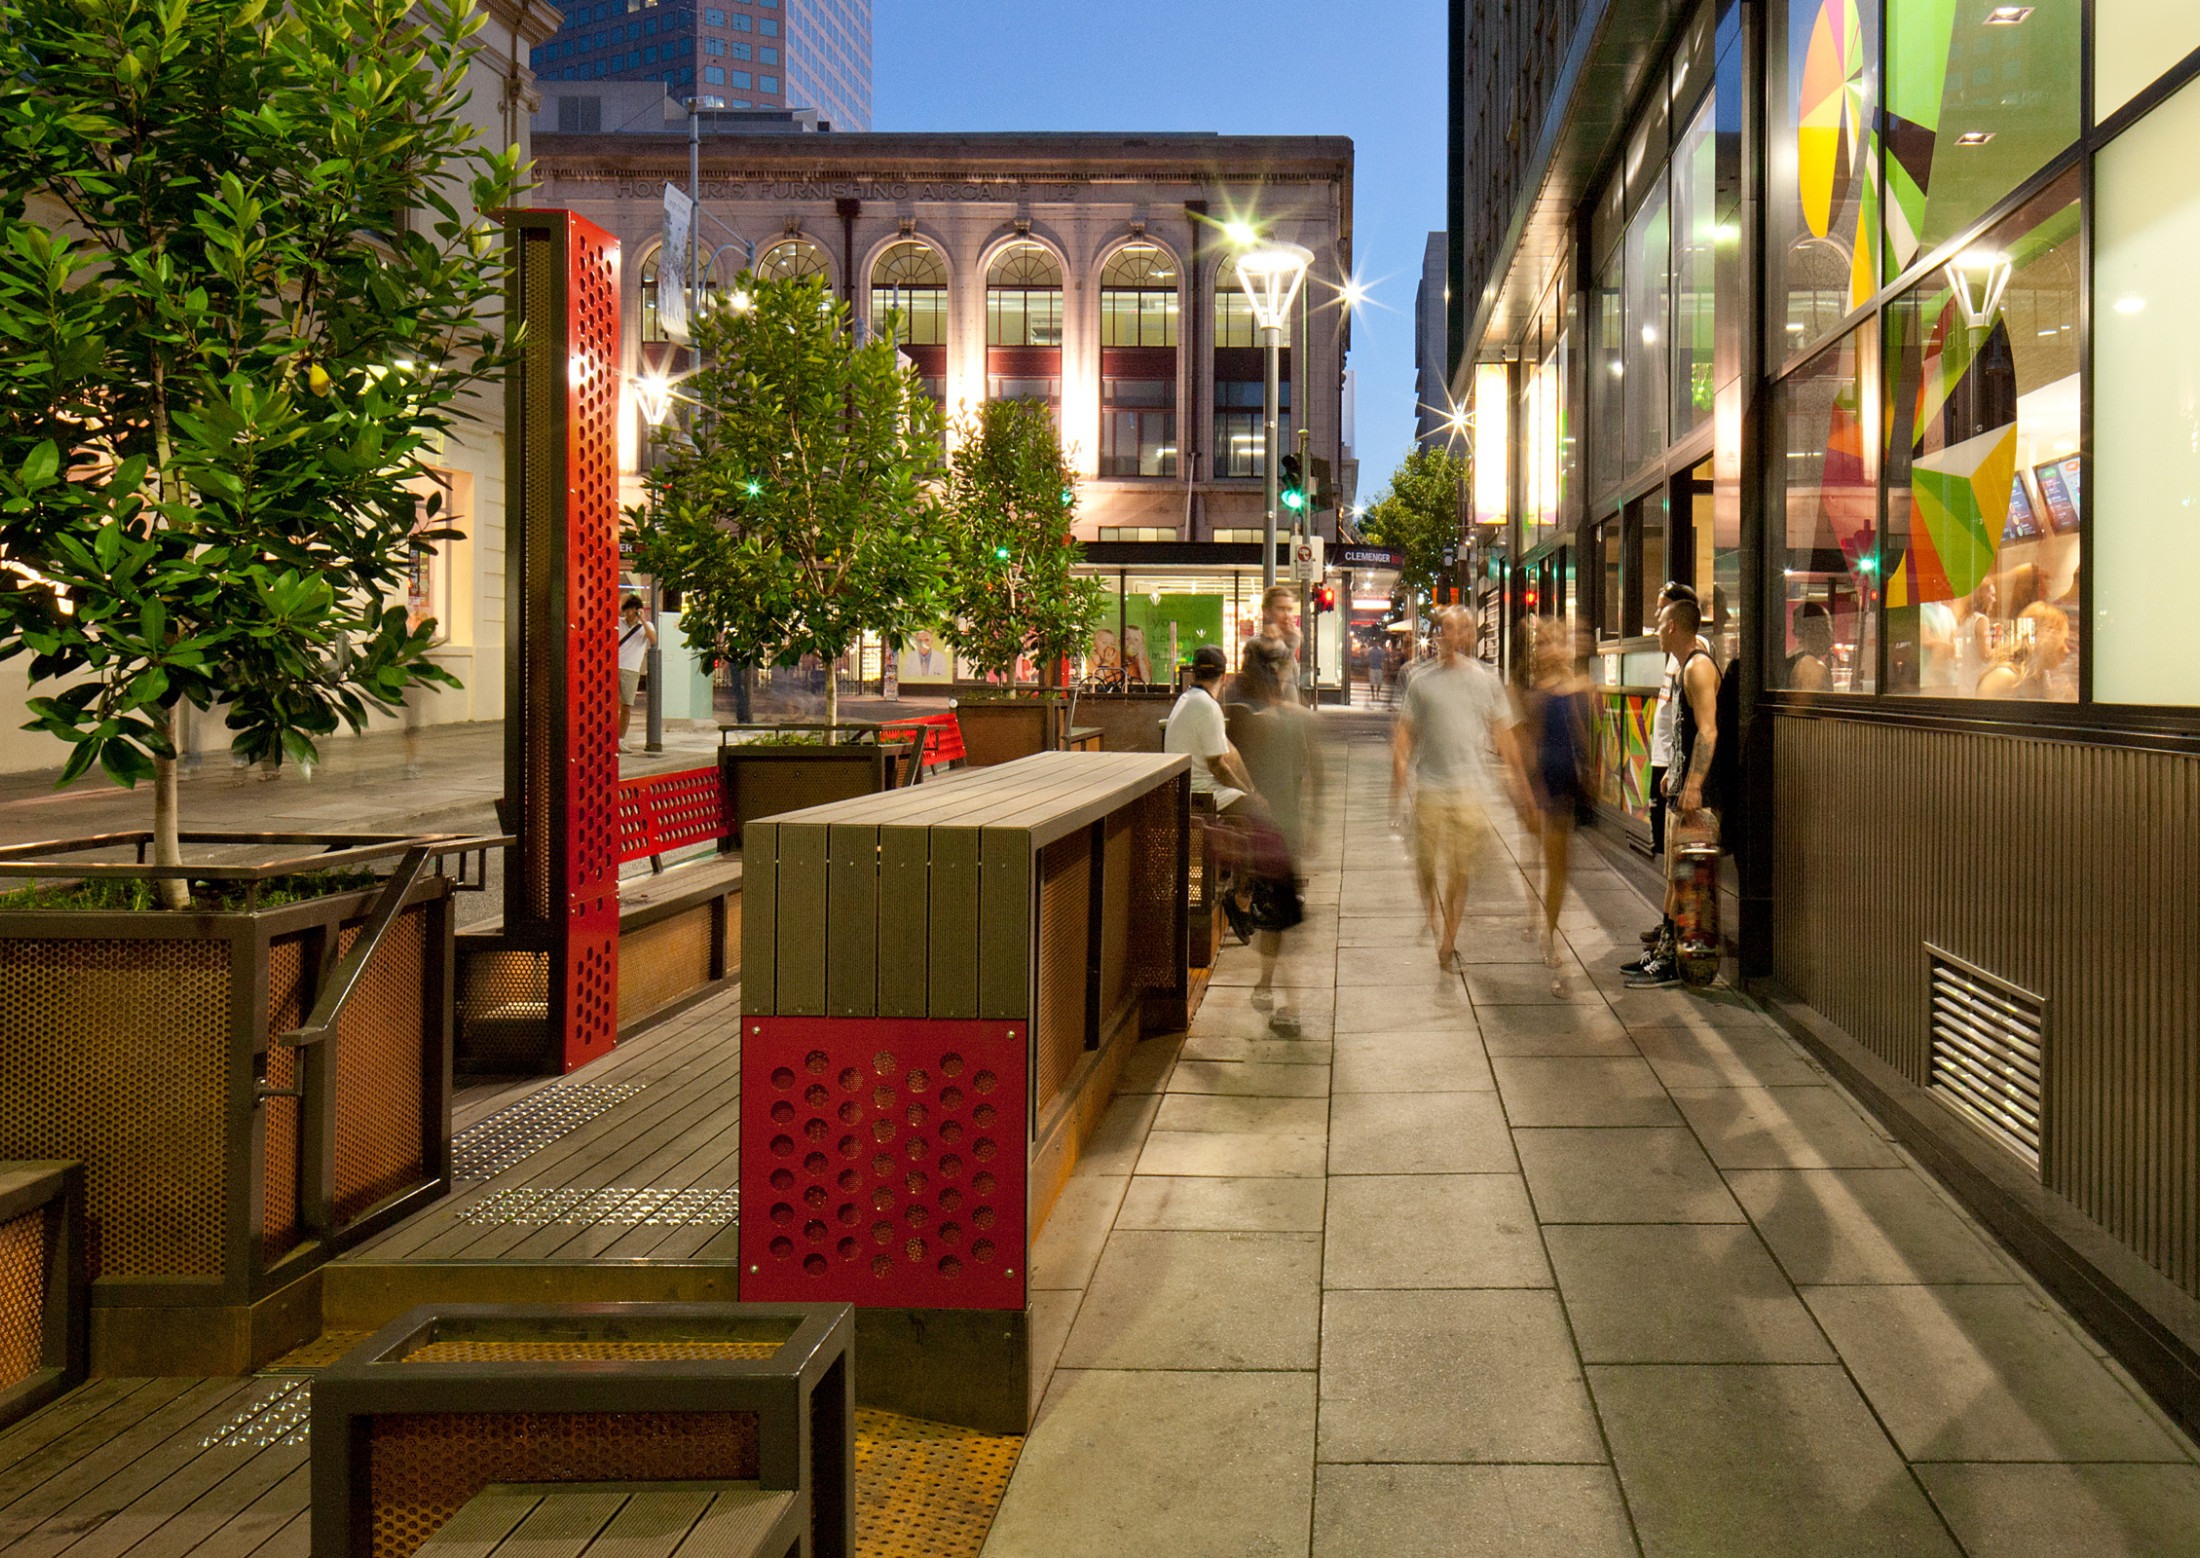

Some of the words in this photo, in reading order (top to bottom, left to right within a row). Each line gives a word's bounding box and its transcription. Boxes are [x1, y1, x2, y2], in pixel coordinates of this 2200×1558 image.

[758, 182, 909, 200] FURNISHING
[919, 182, 1030, 201] ARCADE
[1344, 551, 1391, 563] CLEMENGER
